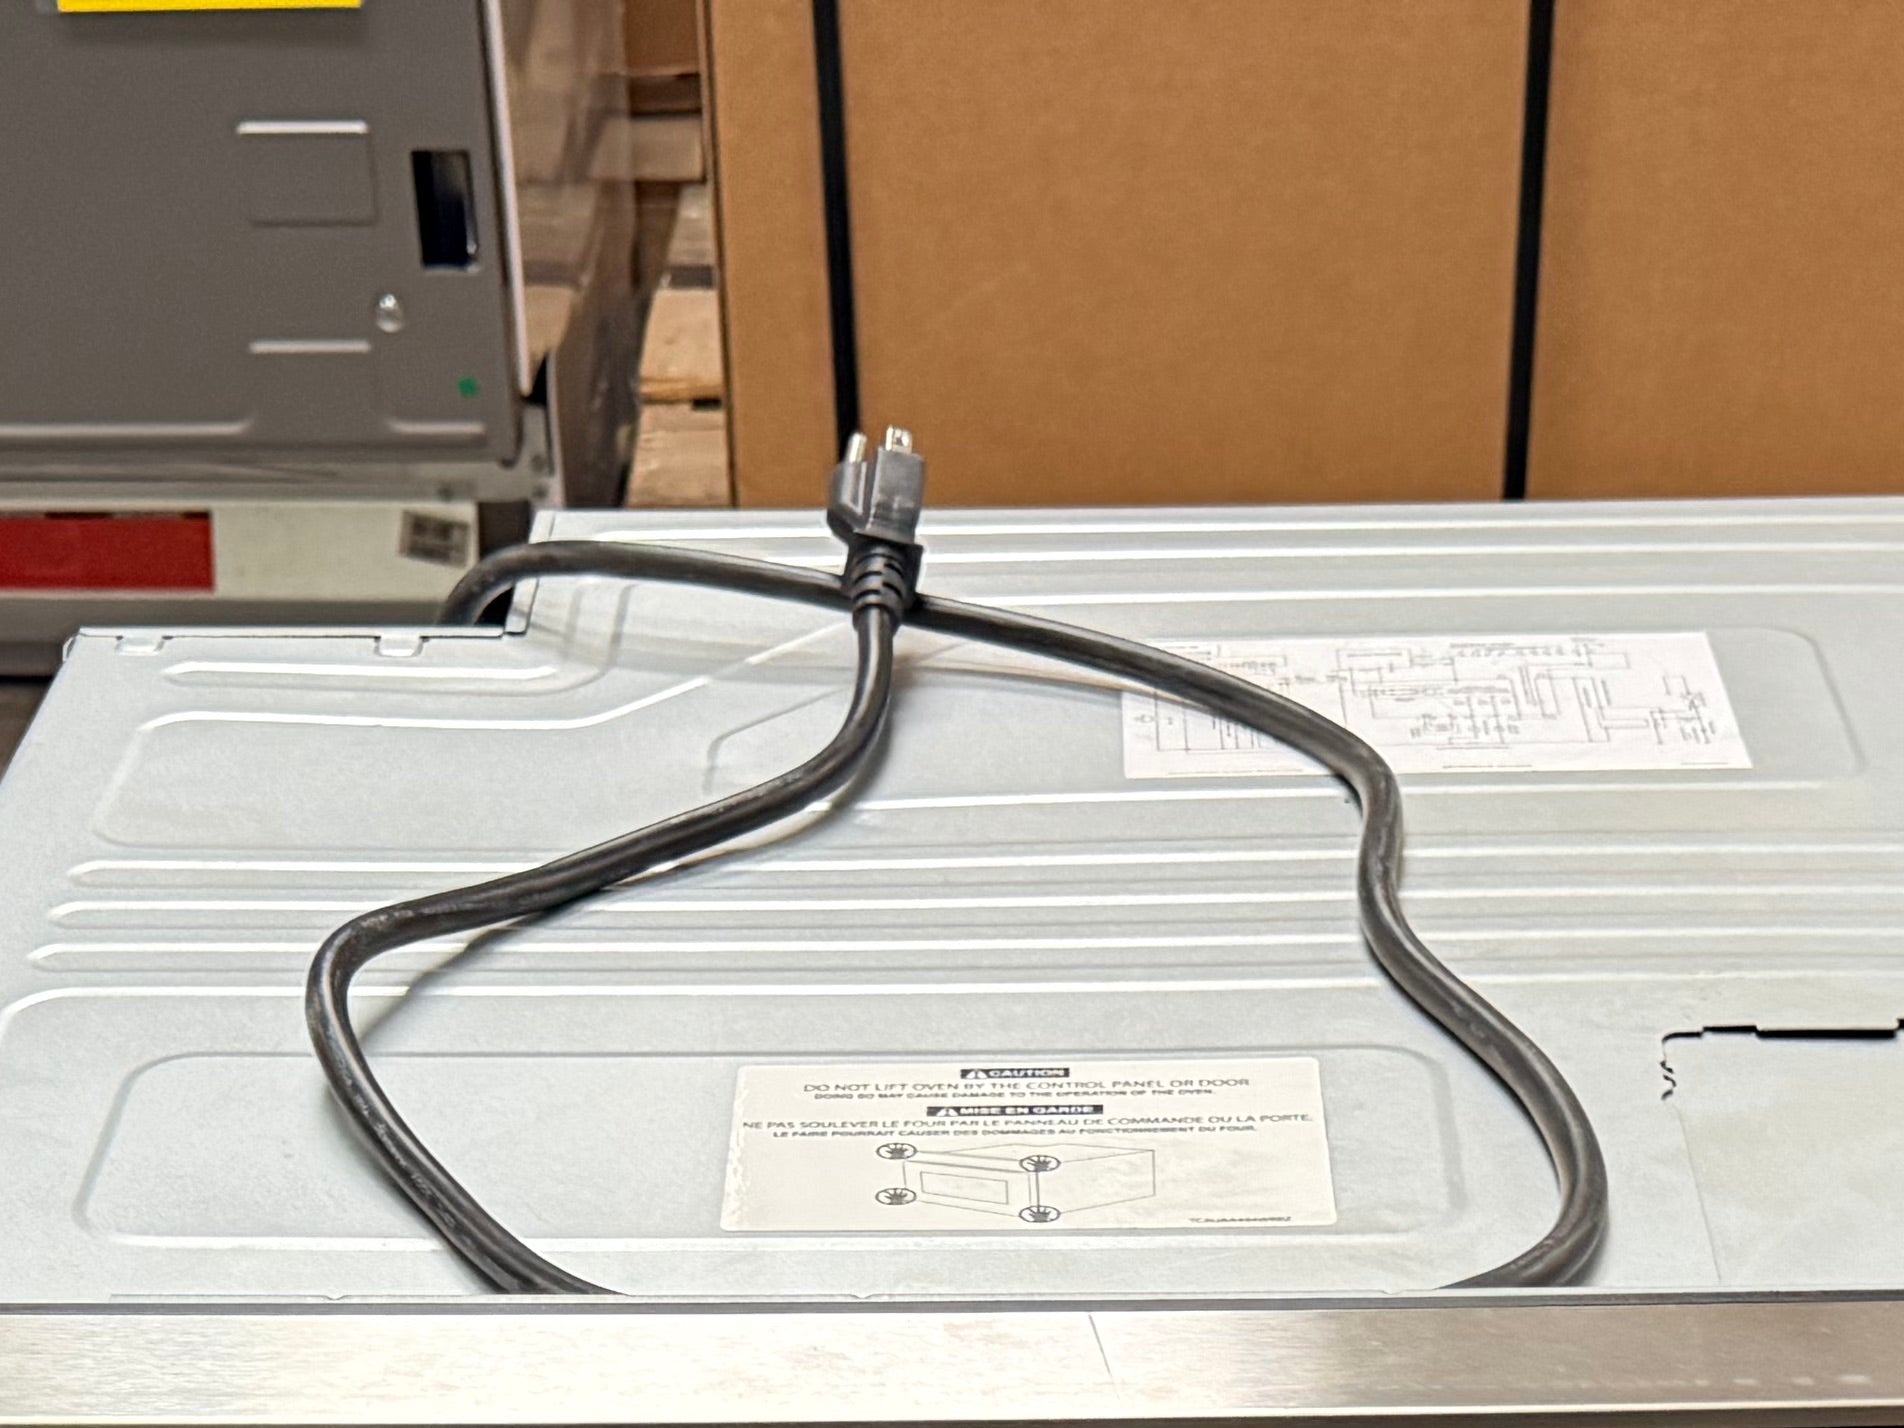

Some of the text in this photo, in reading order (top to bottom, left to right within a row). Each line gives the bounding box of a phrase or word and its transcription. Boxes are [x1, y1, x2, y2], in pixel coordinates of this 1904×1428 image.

[989, 1069, 1065, 1078] CAUTION
[803, 1084, 831, 1092] DO
[834, 1083, 870, 1091] NOT
[875, 1083, 908, 1091] LIFT
[912, 1083, 959, 1091] OVEN
[991, 1082, 1021, 1090] THE
[1026, 1081, 1105, 1090] CONTROL
[1112, 1080, 1164, 1088] PANEL
[1169, 1079, 1194, 1087] OR
[1198, 1079, 1249, 1087] DOOR
[959, 1107, 1001, 1115] MISE
[1032, 1106, 1095, 1114] GARDE
[743, 1121, 762, 1129] NE
[767, 1121, 795, 1129] PAS
[799, 1120, 878, 1128] SOULEVER
[882, 1120, 899, 1128] LE
[903, 1119, 946, 1128] FOUR
[1004, 1118, 1079, 1126] PANNEAU
[1107, 1116, 1203, 1125] COMMANDE
[1208, 1115, 1232, 1123] OU
[1259, 1114, 1313, 1122] PORTE.
